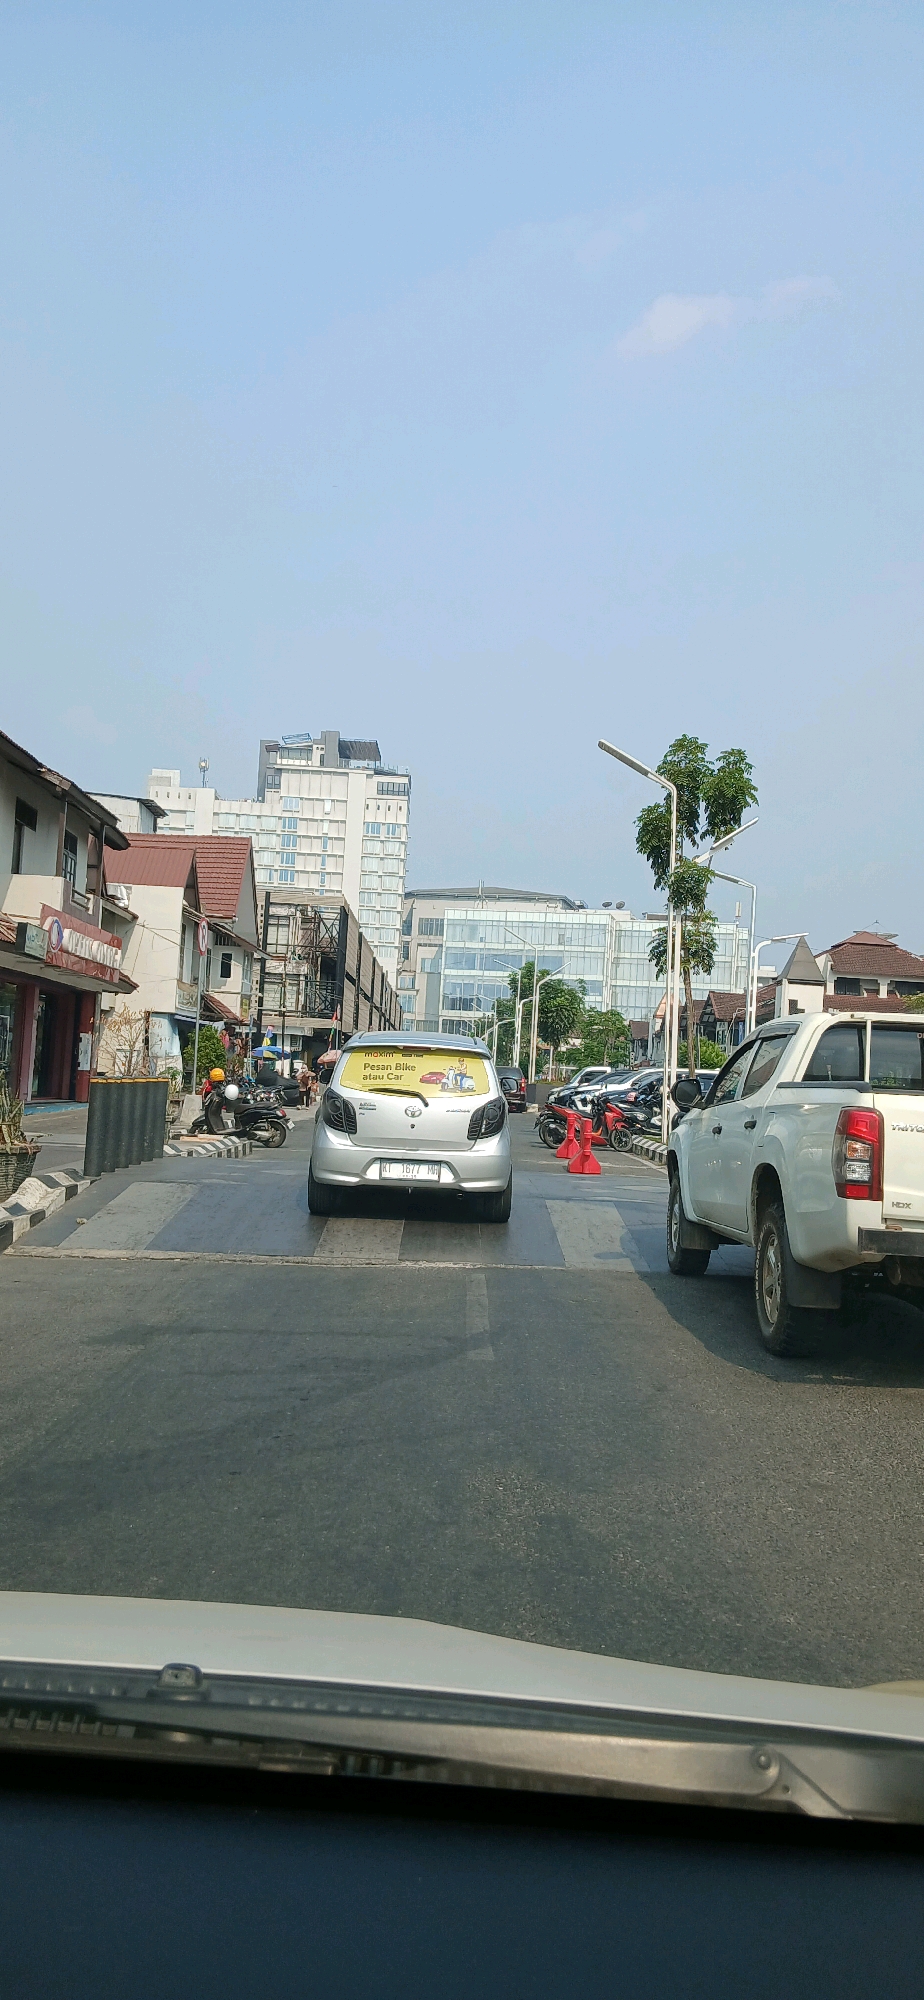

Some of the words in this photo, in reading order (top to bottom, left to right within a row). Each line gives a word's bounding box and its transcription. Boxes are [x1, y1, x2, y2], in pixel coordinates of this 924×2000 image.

[363, 1062, 392, 1071] Pesan
[395, 1062, 416, 1071] Bike
[362, 1073, 384, 1081] atau
[386, 1072, 404, 1081] Car
[382, 1162, 392, 1173] KT
[402, 1163, 421, 1175] 1677
[891, 1201, 912, 1209] HDX
